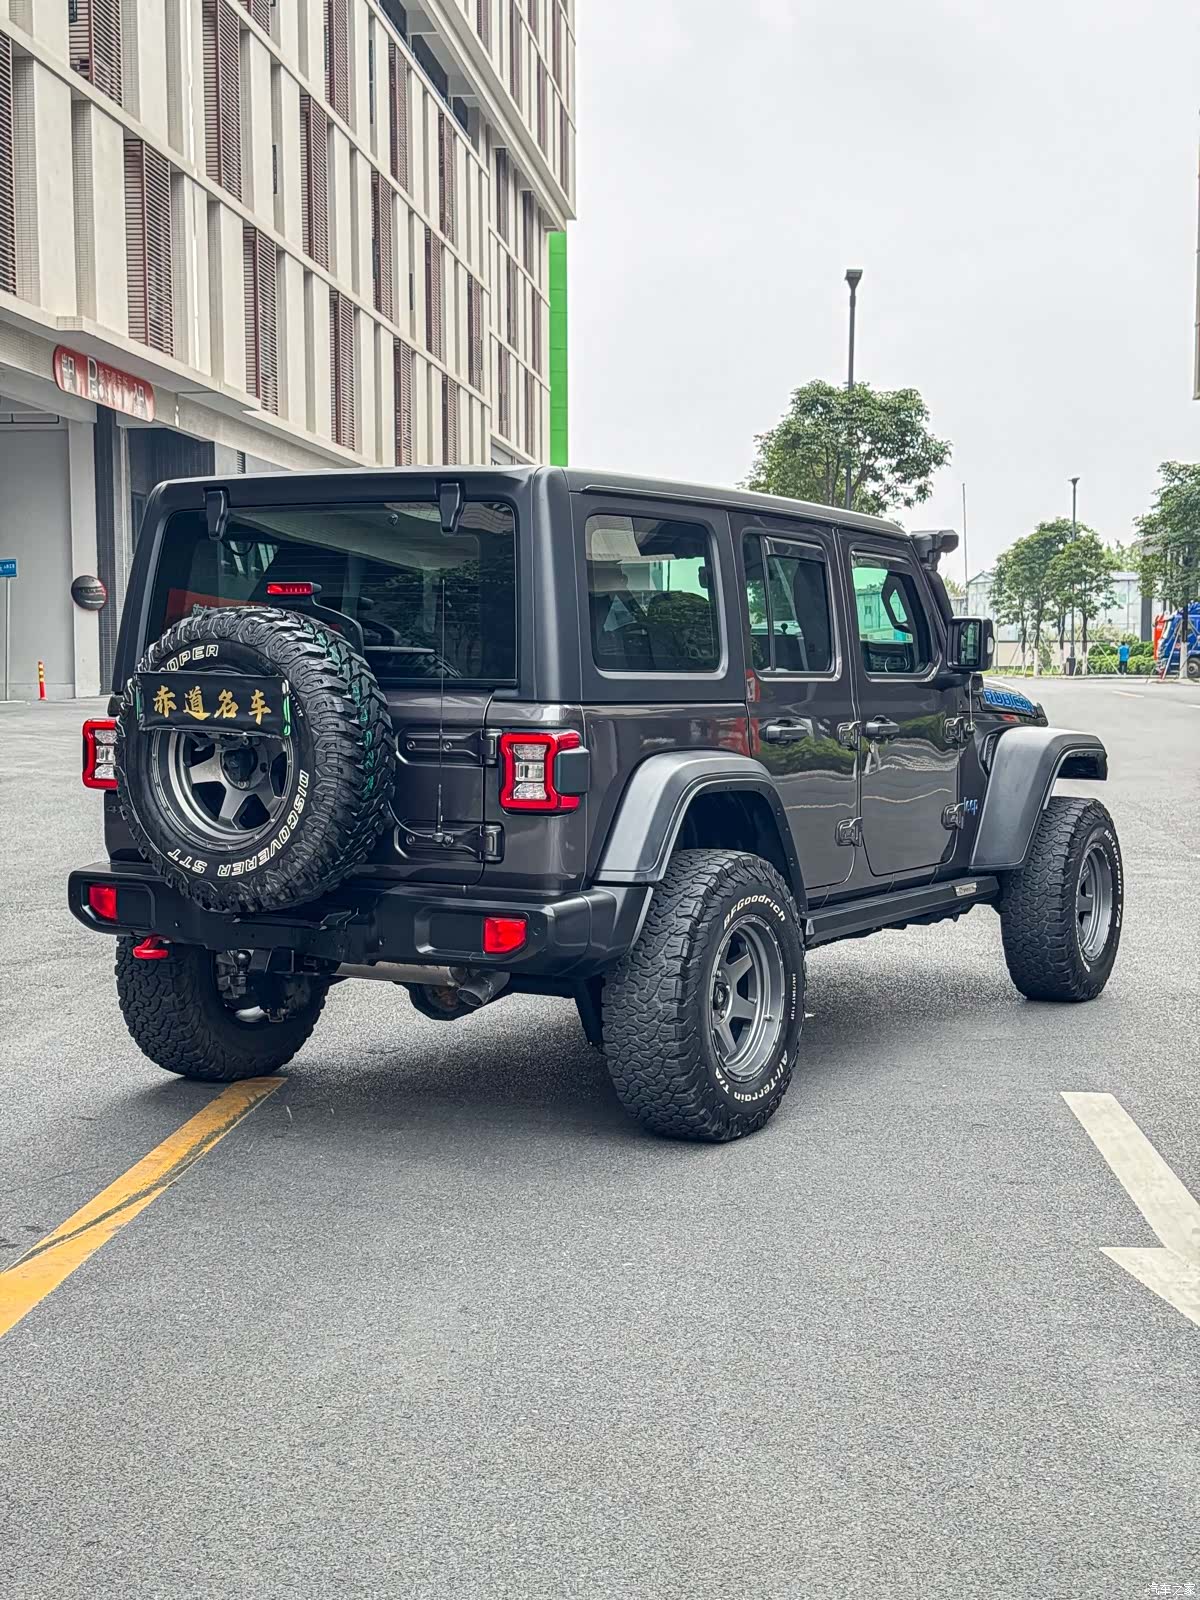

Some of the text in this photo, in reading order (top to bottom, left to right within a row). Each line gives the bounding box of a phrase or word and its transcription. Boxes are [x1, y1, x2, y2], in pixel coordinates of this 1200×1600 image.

[159, 645, 219, 671] OPER
[153, 685, 272, 725] 赤道名车
[167, 769, 309, 877] DISCOVERER STT
[723, 894, 786, 930] BFGoodrich
[734, 1049, 788, 1103] All-Terrain
